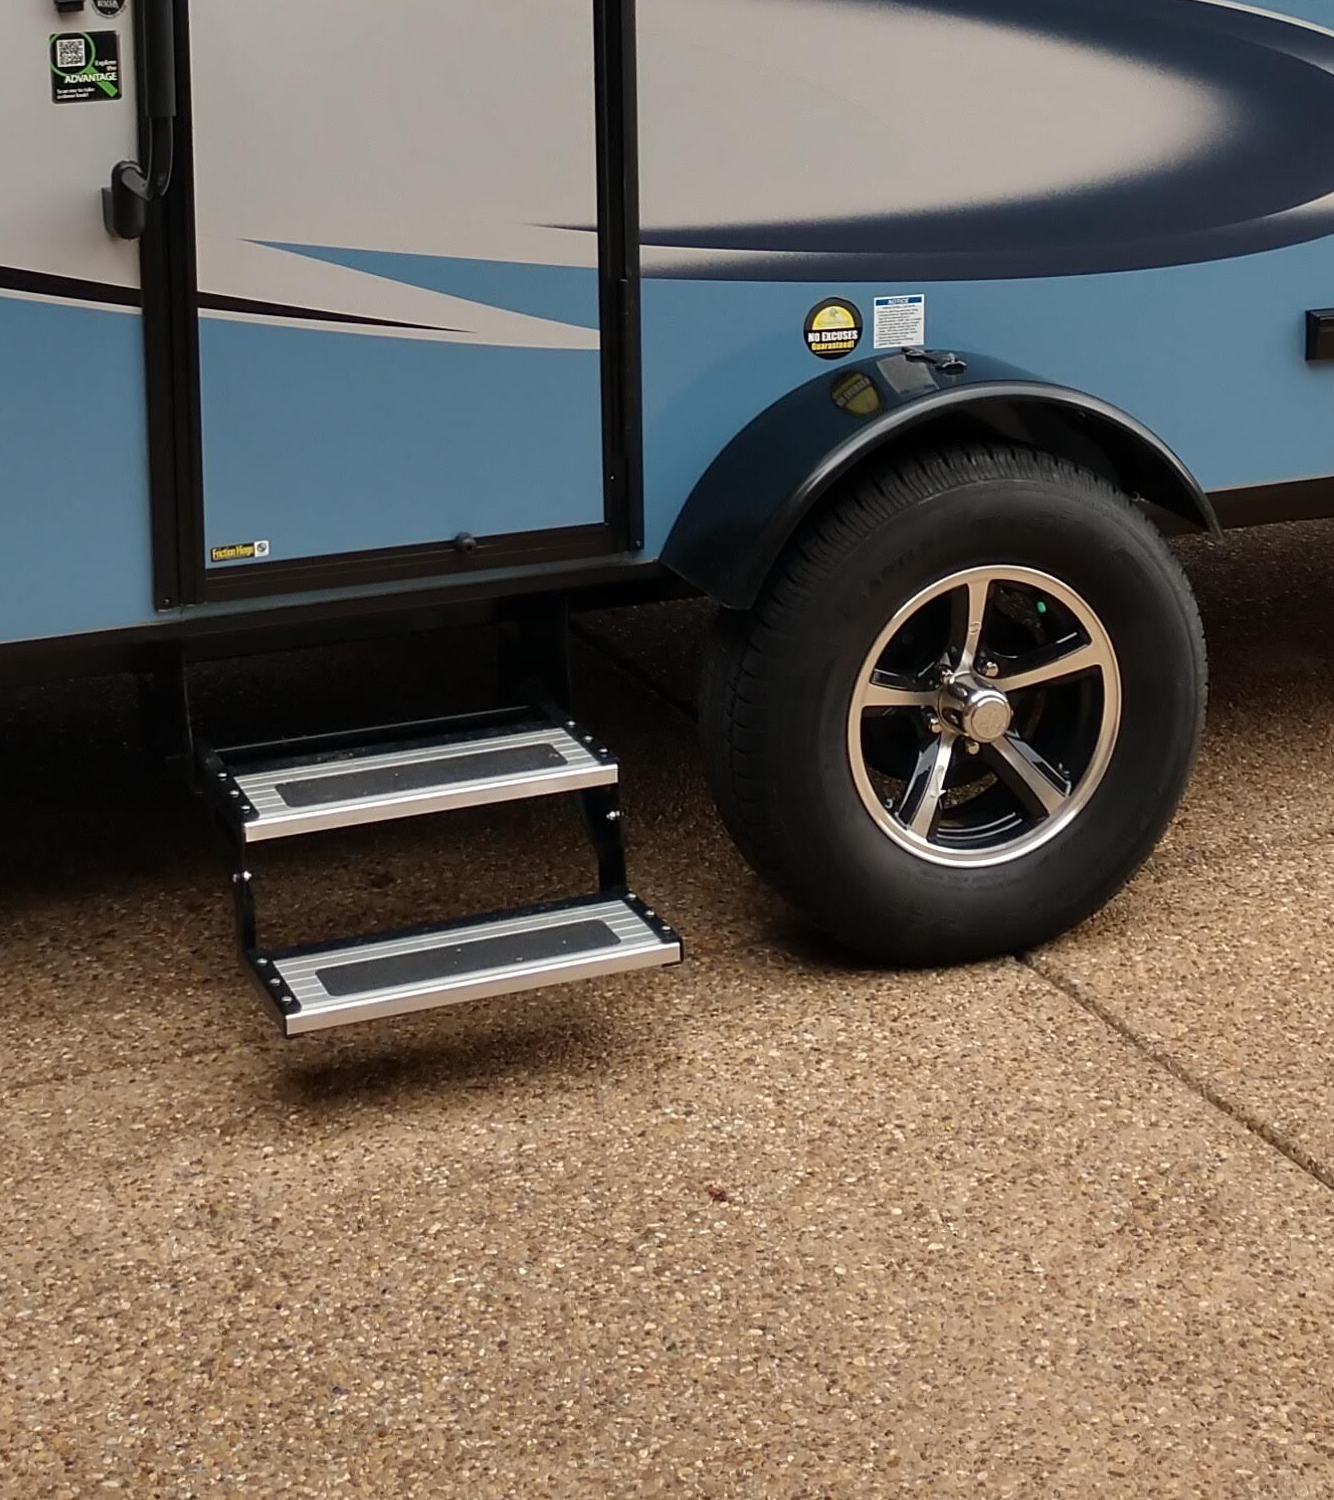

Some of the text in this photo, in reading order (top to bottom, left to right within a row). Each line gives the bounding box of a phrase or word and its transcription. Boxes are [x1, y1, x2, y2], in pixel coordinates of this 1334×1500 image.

[64, 72, 118, 84] ADVANTAGE
[808, 330, 858, 343] NO EXCUSES
